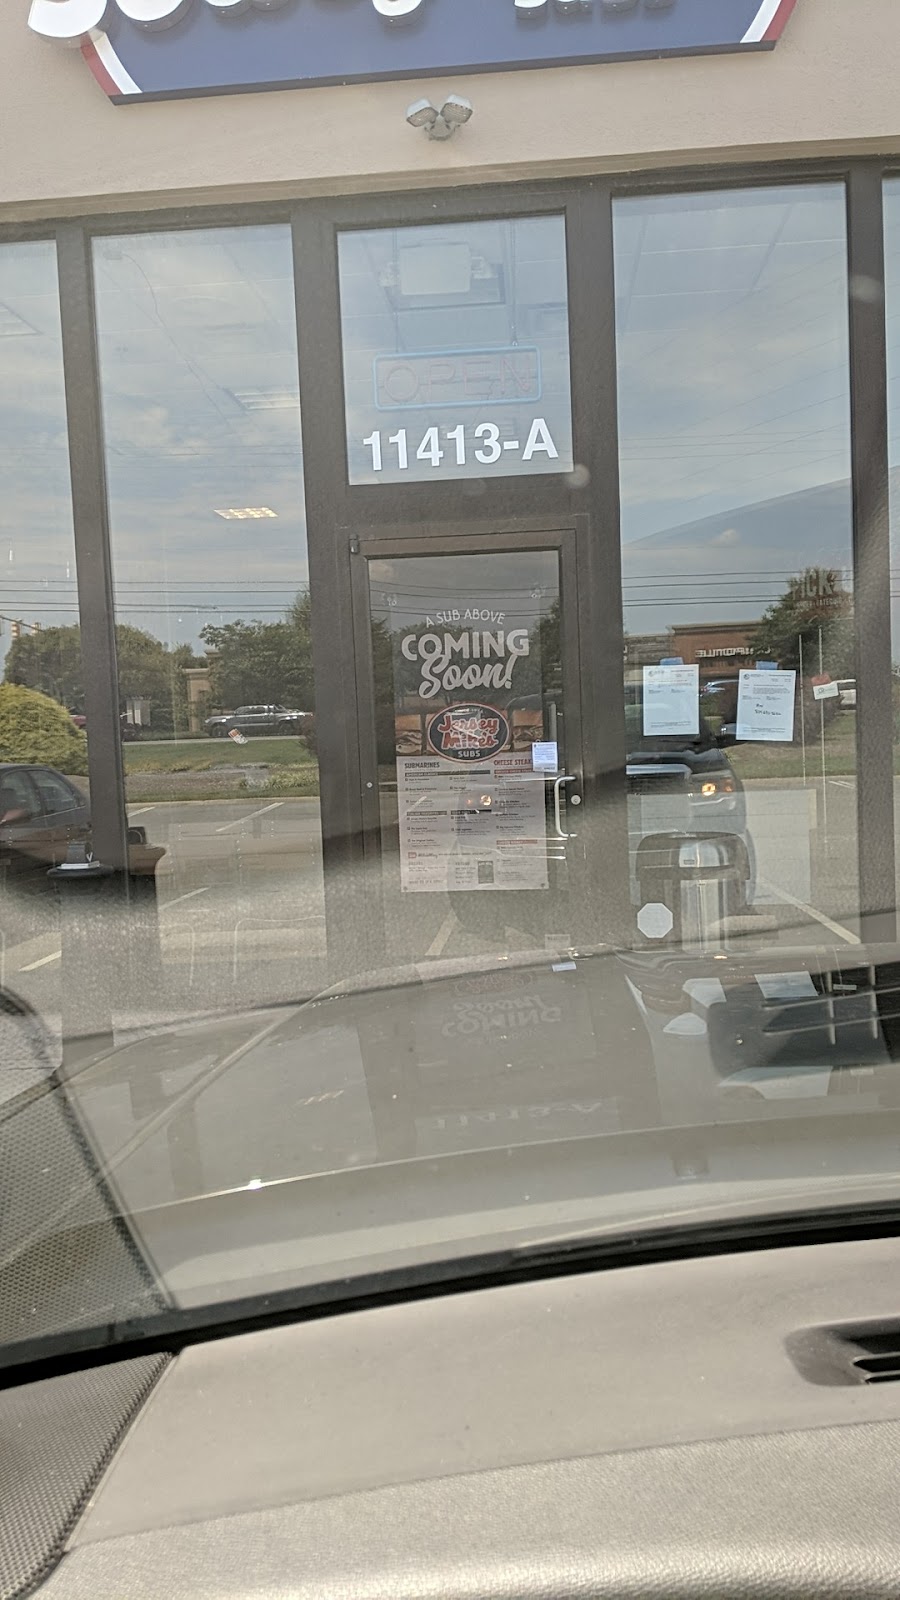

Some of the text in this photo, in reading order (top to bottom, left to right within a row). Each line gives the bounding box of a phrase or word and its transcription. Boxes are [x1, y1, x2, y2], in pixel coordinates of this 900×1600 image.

[383, 357, 532, 404] OPEN
[363, 418, 559, 471] 11413-A
[425, 608, 506, 629] A SUB ABOVE
[401, 629, 530, 661] COMING
[418, 654, 519, 699] Soon!
[437, 714, 500, 735] Jersey
[404, 761, 440, 769] SUBMARINES
[457, 750, 481, 759] SUBS
[514, 758, 532, 766] STEAK
